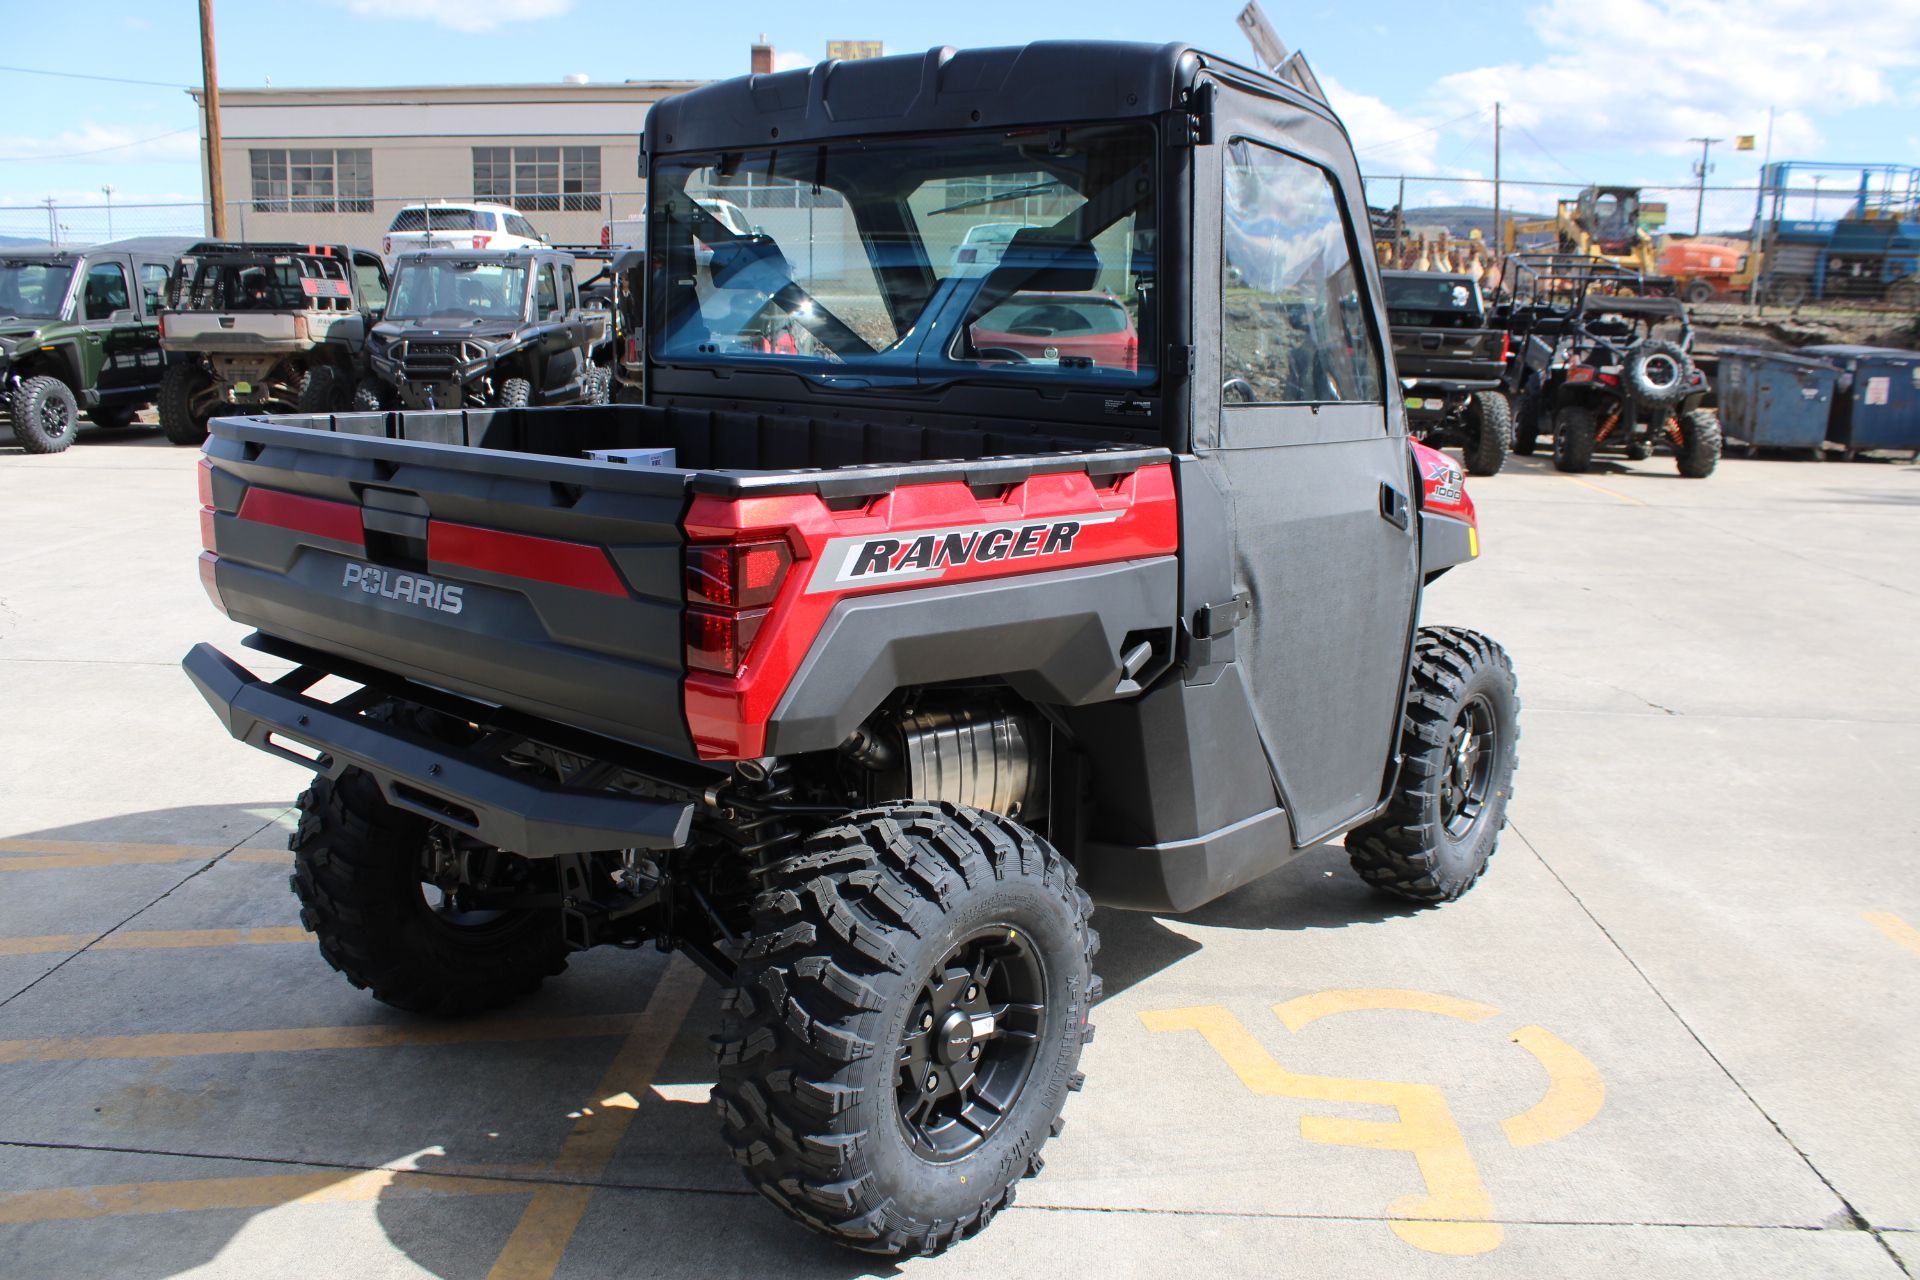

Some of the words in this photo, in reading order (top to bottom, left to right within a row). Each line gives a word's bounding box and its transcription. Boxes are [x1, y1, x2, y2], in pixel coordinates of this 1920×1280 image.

[829, 41, 881, 60] EAT
[1426, 462, 1463, 485] XP
[1435, 486, 1461, 500] 1000
[849, 520, 1081, 577] RANGER
[342, 562, 464, 615] POLARIS
